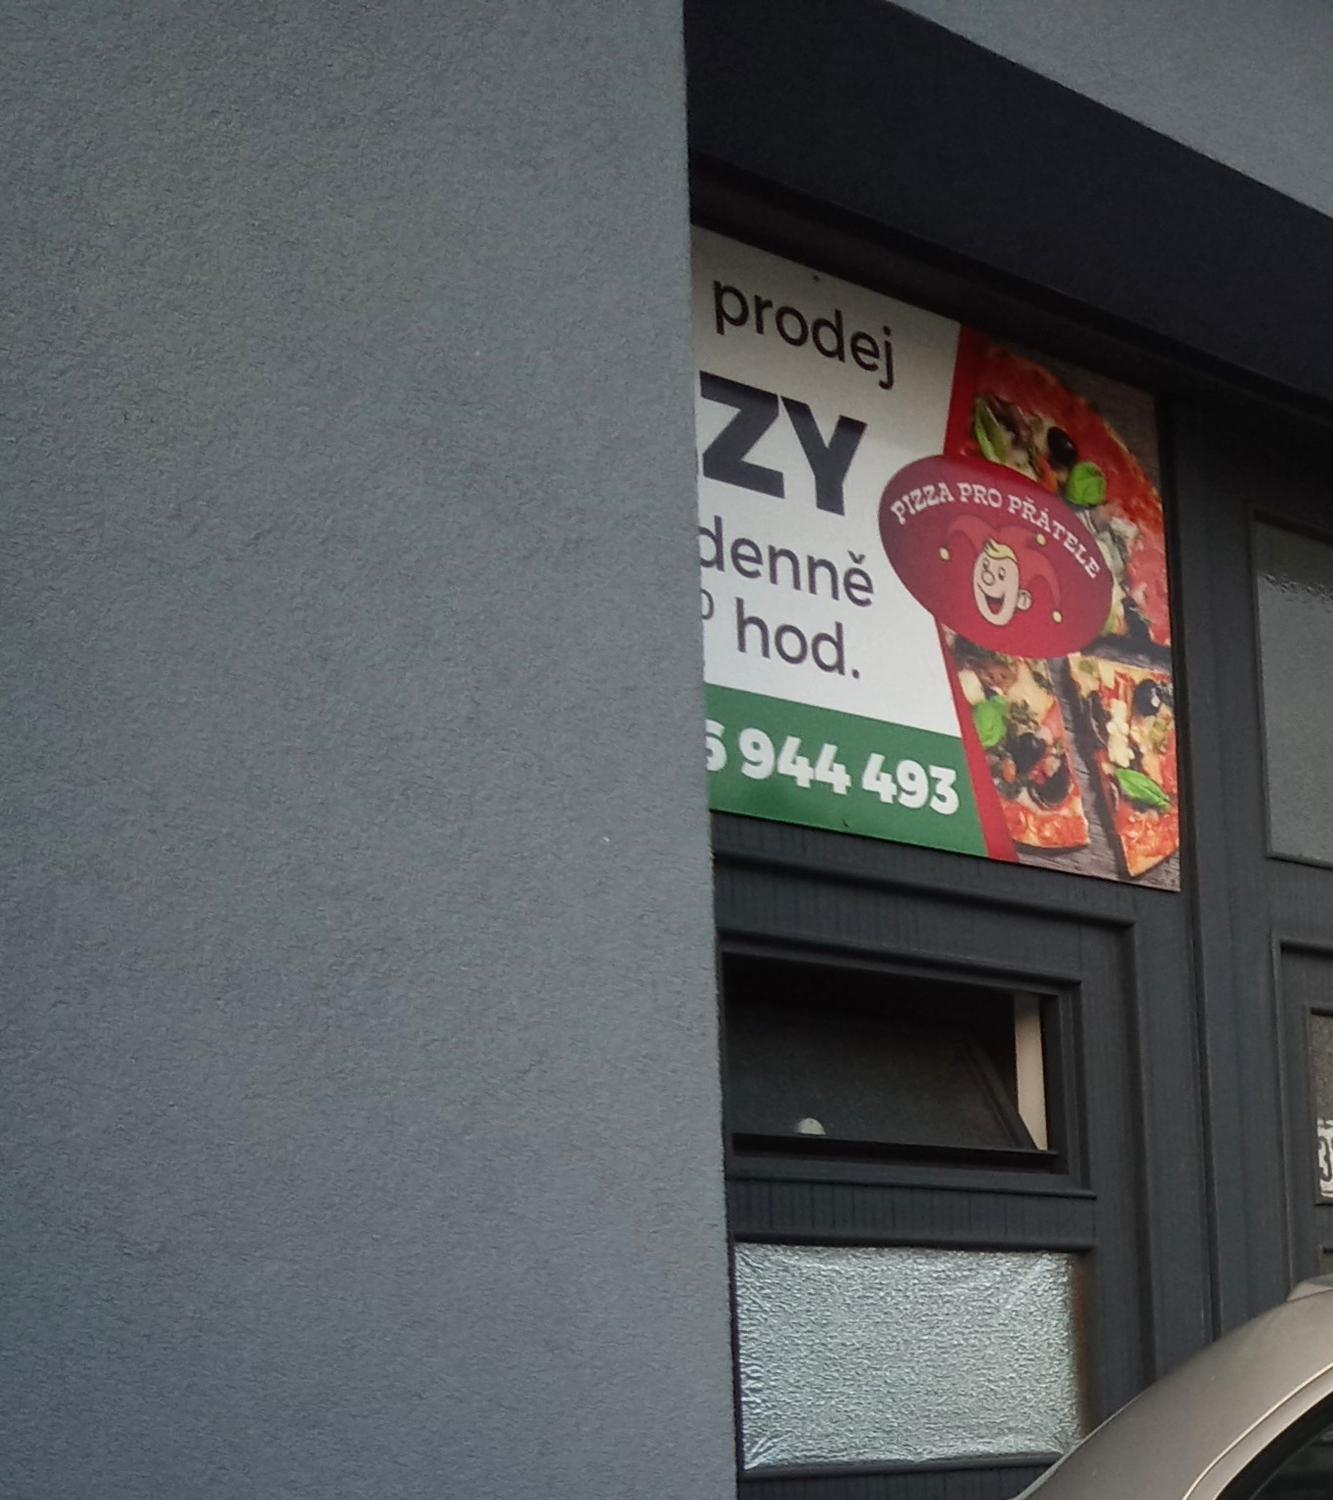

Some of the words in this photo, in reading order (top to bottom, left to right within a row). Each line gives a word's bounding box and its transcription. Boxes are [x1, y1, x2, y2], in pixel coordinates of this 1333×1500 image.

[713, 280, 894, 389] prodej
[890, 482, 954, 525] PIZZA
[957, 482, 1002, 509] PRO
[1007, 493, 1101, 579] PŘÁTELE
[735, 597, 859, 679] hod.
[739, 727, 851, 795] 944
[861, 752, 960, 815] 493
